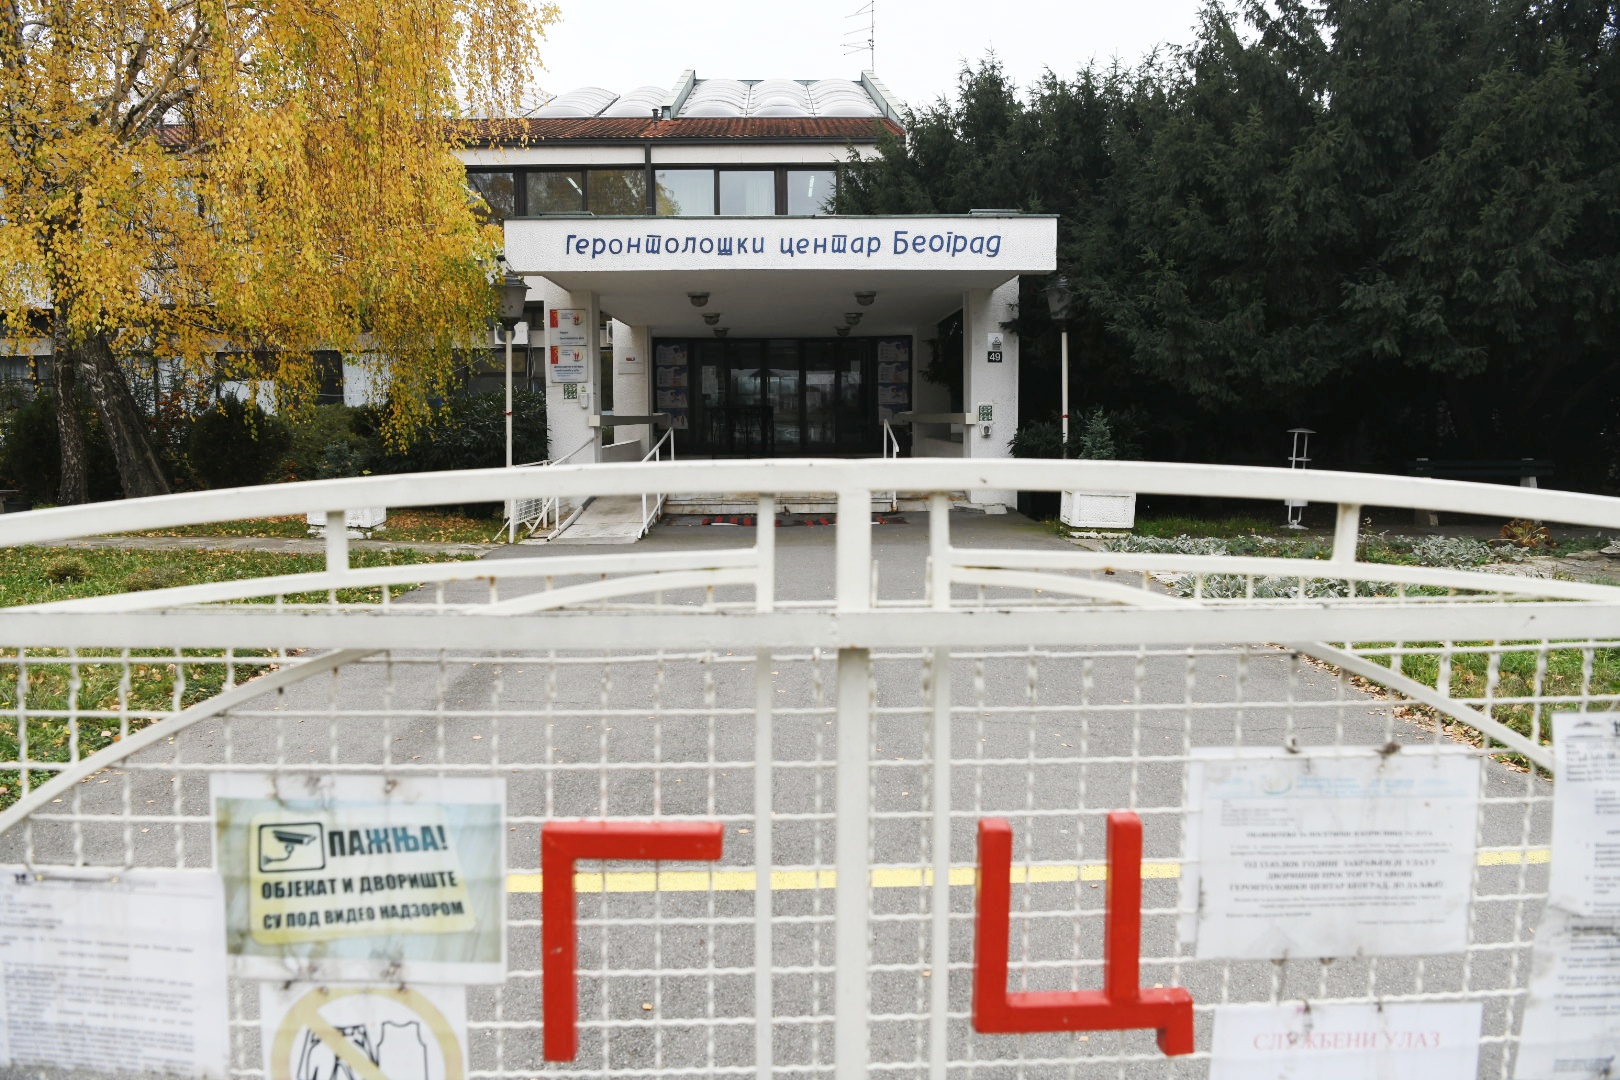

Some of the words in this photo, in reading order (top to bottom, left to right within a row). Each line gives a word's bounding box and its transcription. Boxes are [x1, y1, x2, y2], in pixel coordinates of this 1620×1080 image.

[565, 234, 765, 259] Геронтолошки
[779, 234, 882, 258] центар
[893, 230, 1002, 258] Београд
[989, 352, 1001, 361] 49
[328, 825, 449, 857] ПАЖЊА!
[260, 878, 338, 900] ОБЈЕКАТ
[342, 878, 354, 893] И
[359, 870, 458, 896] ДВОРИШТЕ
[263, 913, 281, 930] СУ
[286, 910, 321, 929] ПОД
[324, 906, 375, 925] ВИДЕО
[379, 900, 465, 921] НАДЗОРОМ
[541, 820, 723, 1062] Г
[973, 810, 1194, 1057] Ц
[1380, 1030, 1442, 1050] УЛАЗ
